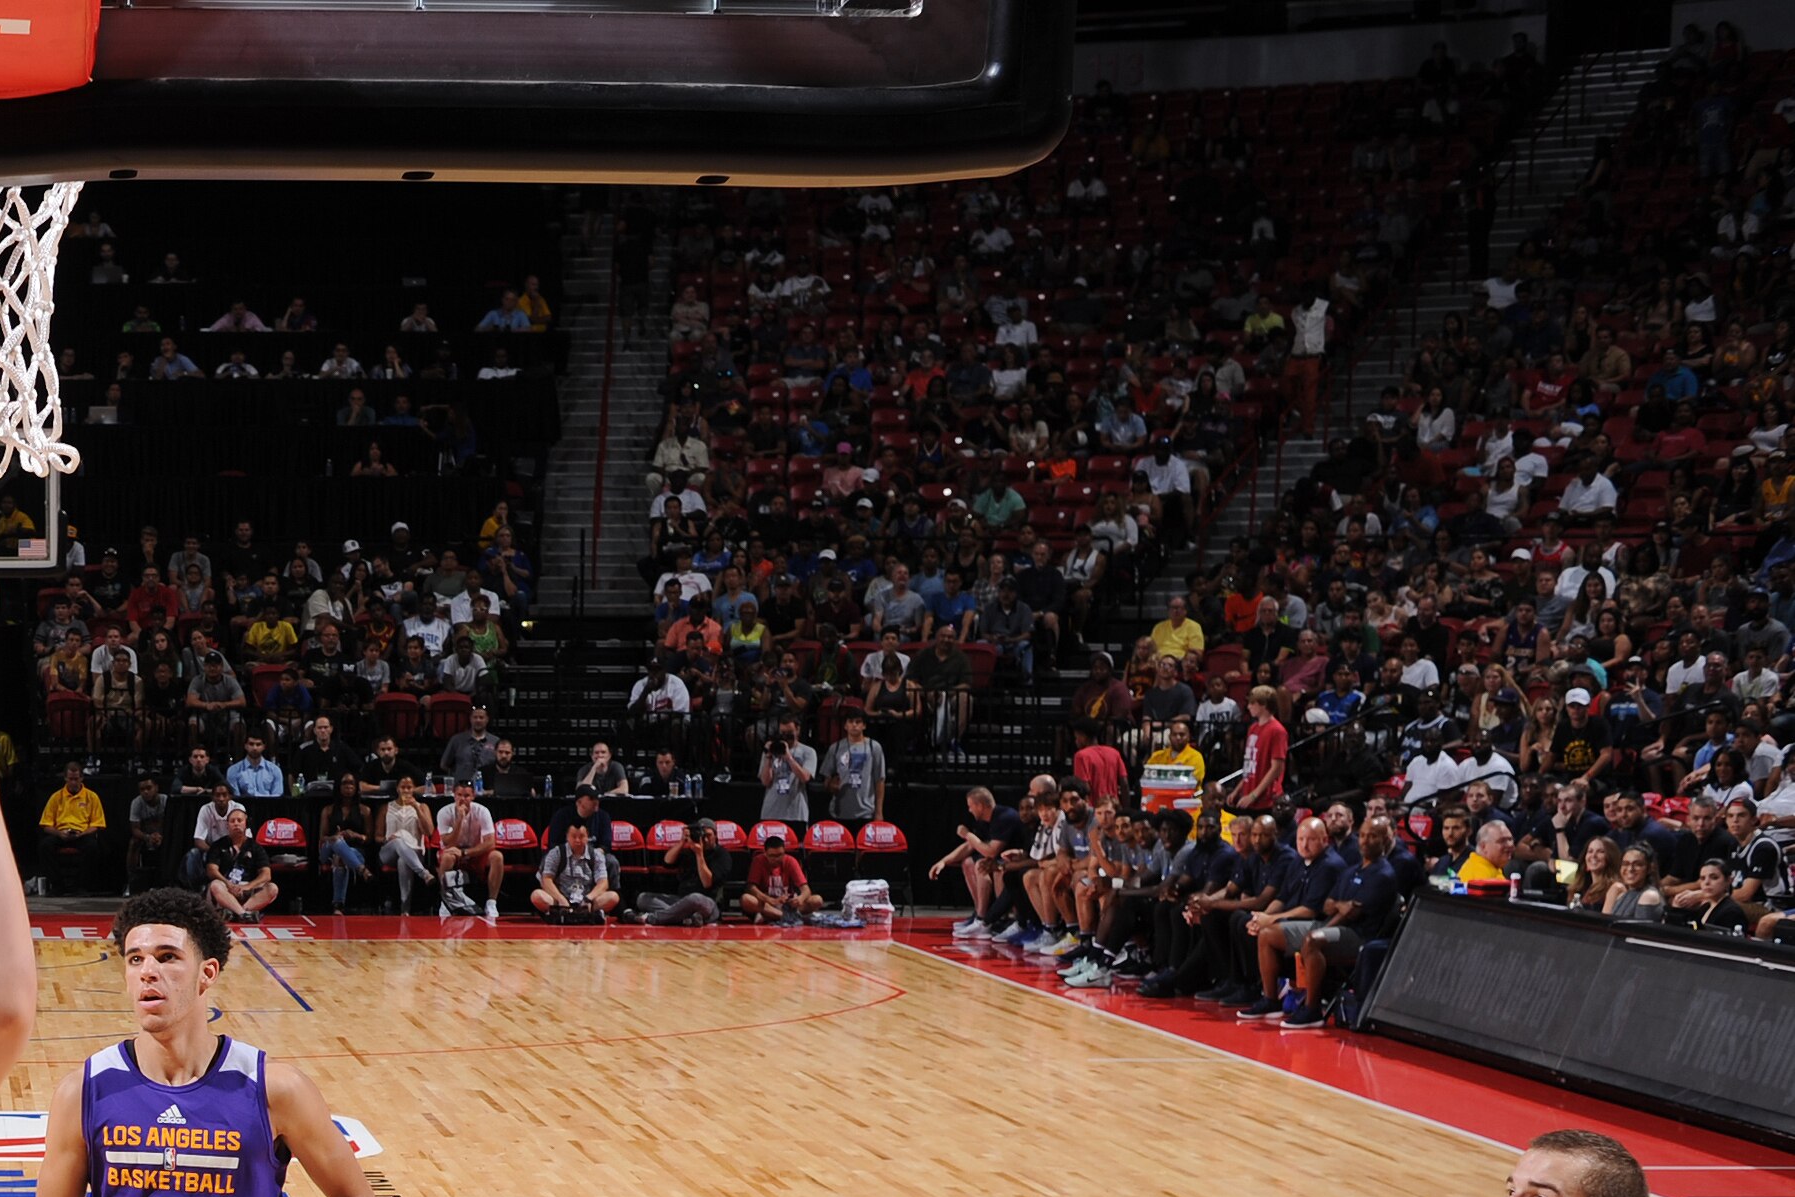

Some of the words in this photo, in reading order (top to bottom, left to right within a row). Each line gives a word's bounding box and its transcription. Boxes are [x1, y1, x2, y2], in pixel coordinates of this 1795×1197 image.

[103, 1126, 142, 1147] LOS
[146, 1126, 241, 1151] ANGELES
[107, 1168, 235, 1194] BASKETBALL
